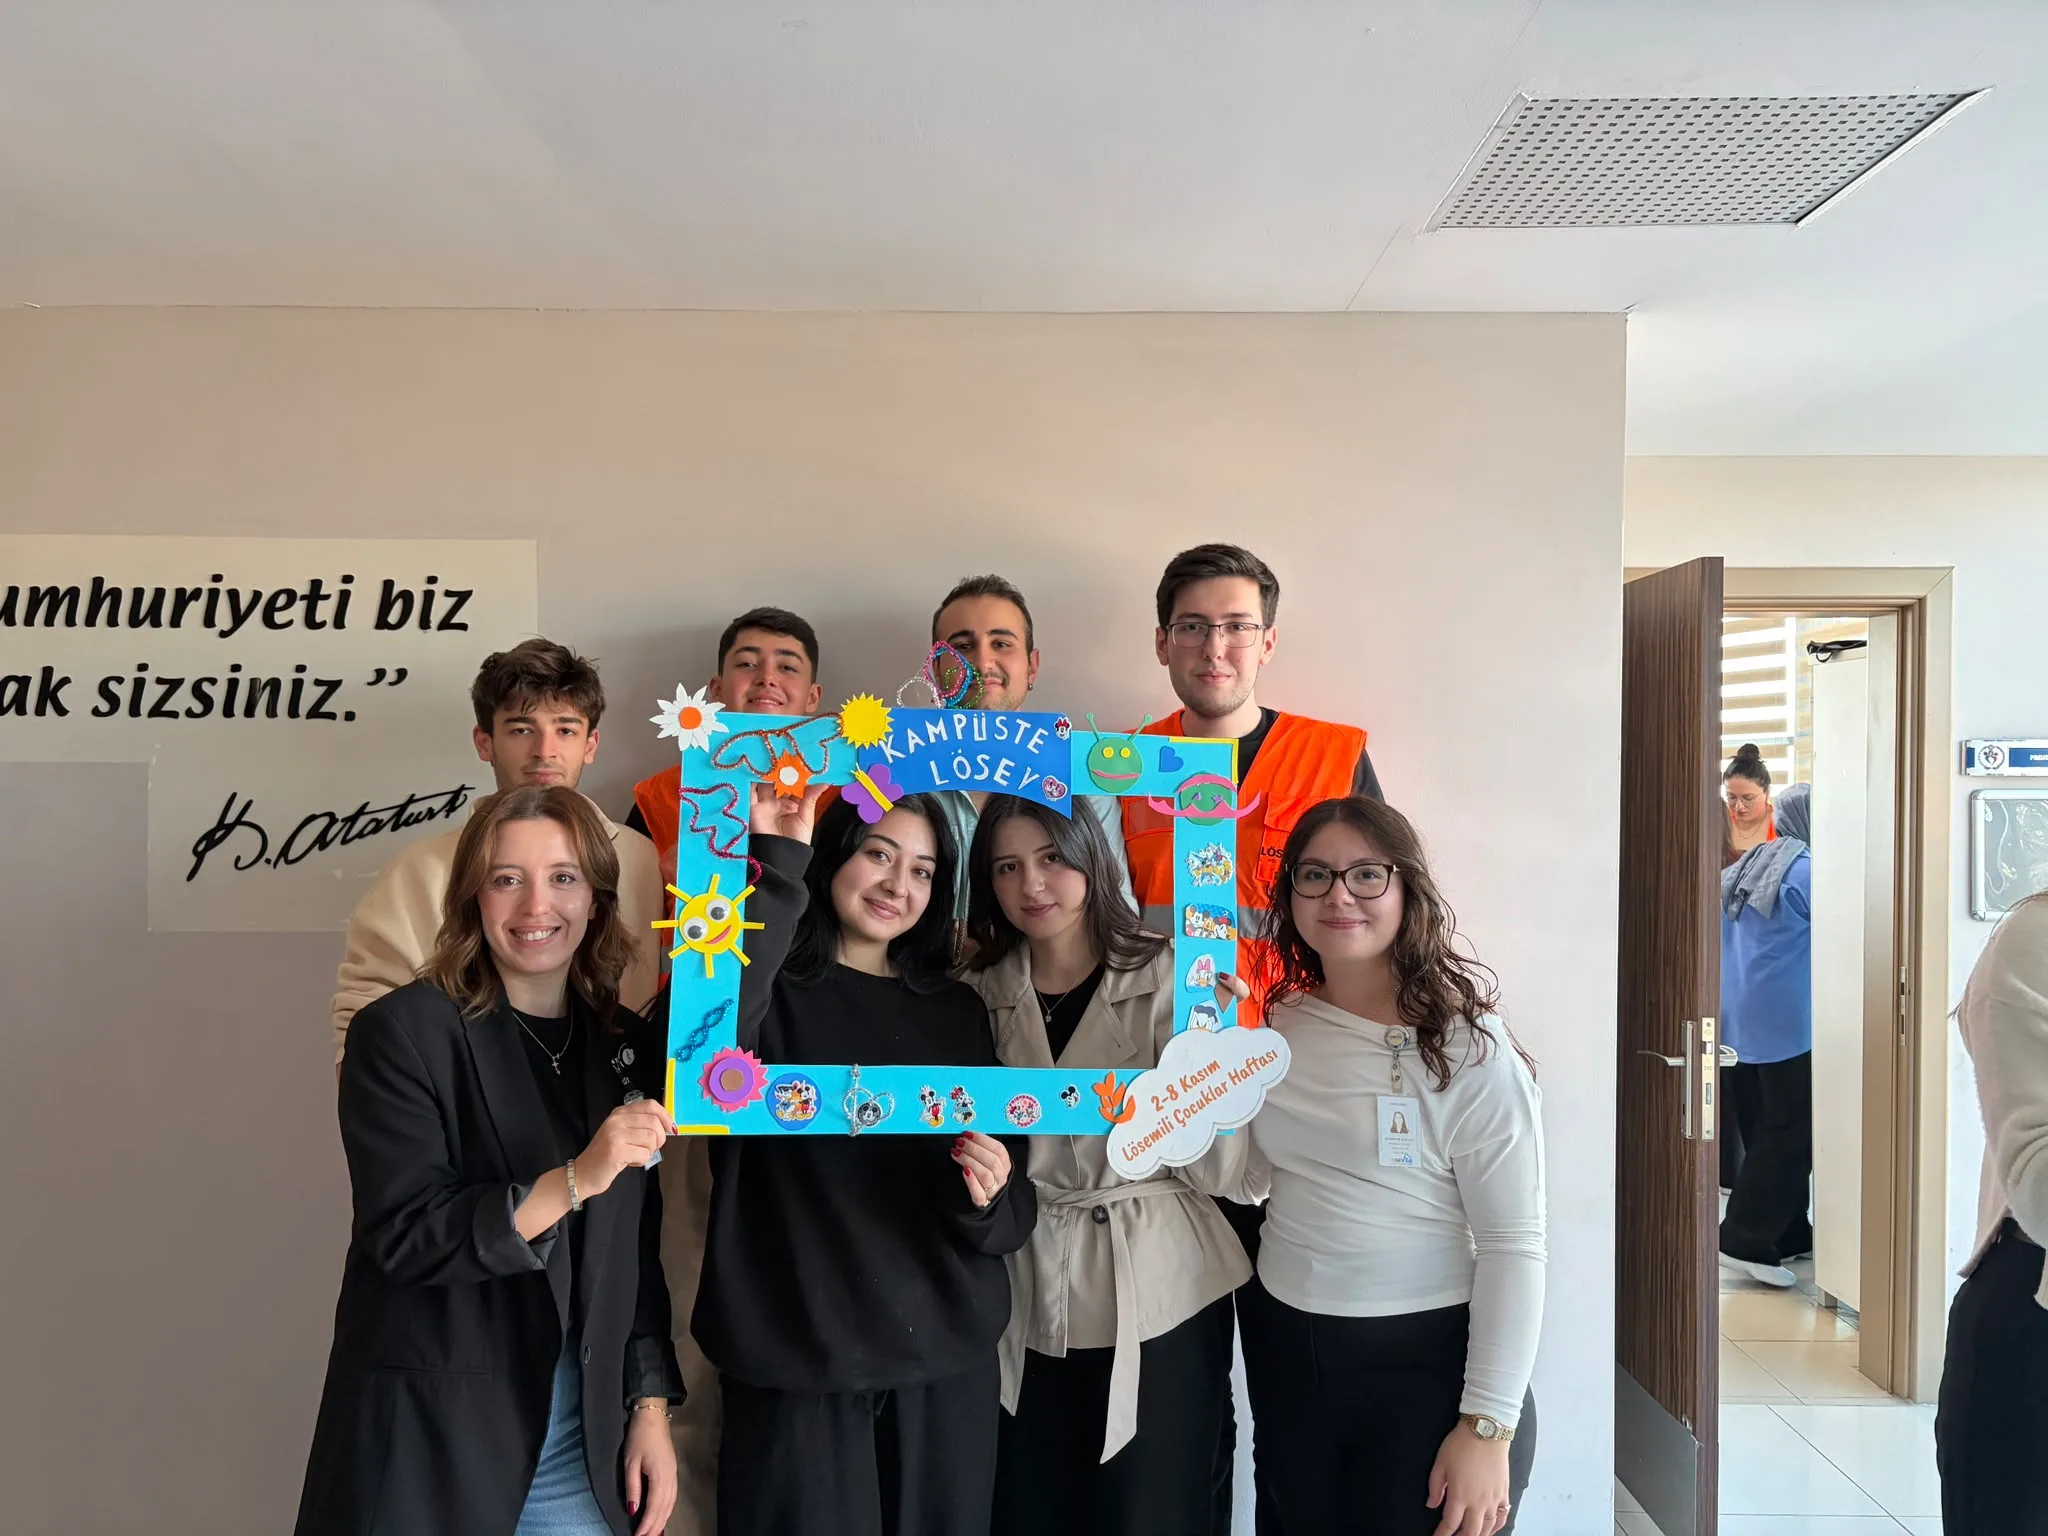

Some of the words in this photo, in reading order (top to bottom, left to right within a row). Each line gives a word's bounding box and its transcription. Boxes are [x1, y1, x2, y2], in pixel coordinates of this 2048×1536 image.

[374, 575, 474, 632] biz
[0, 665, 72, 718] ak
[879, 712, 1049, 764] KAMPÜSTE
[929, 749, 1040, 791] LÖSEV
[1122, 1116, 1175, 1162] Lösemili
[1173, 1081, 1229, 1127] Çocuklar
[1228, 1049, 1279, 1086] Haftası
[1151, 1084, 1179, 1113] 2-8
[1179, 1060, 1221, 1093] Kasım
